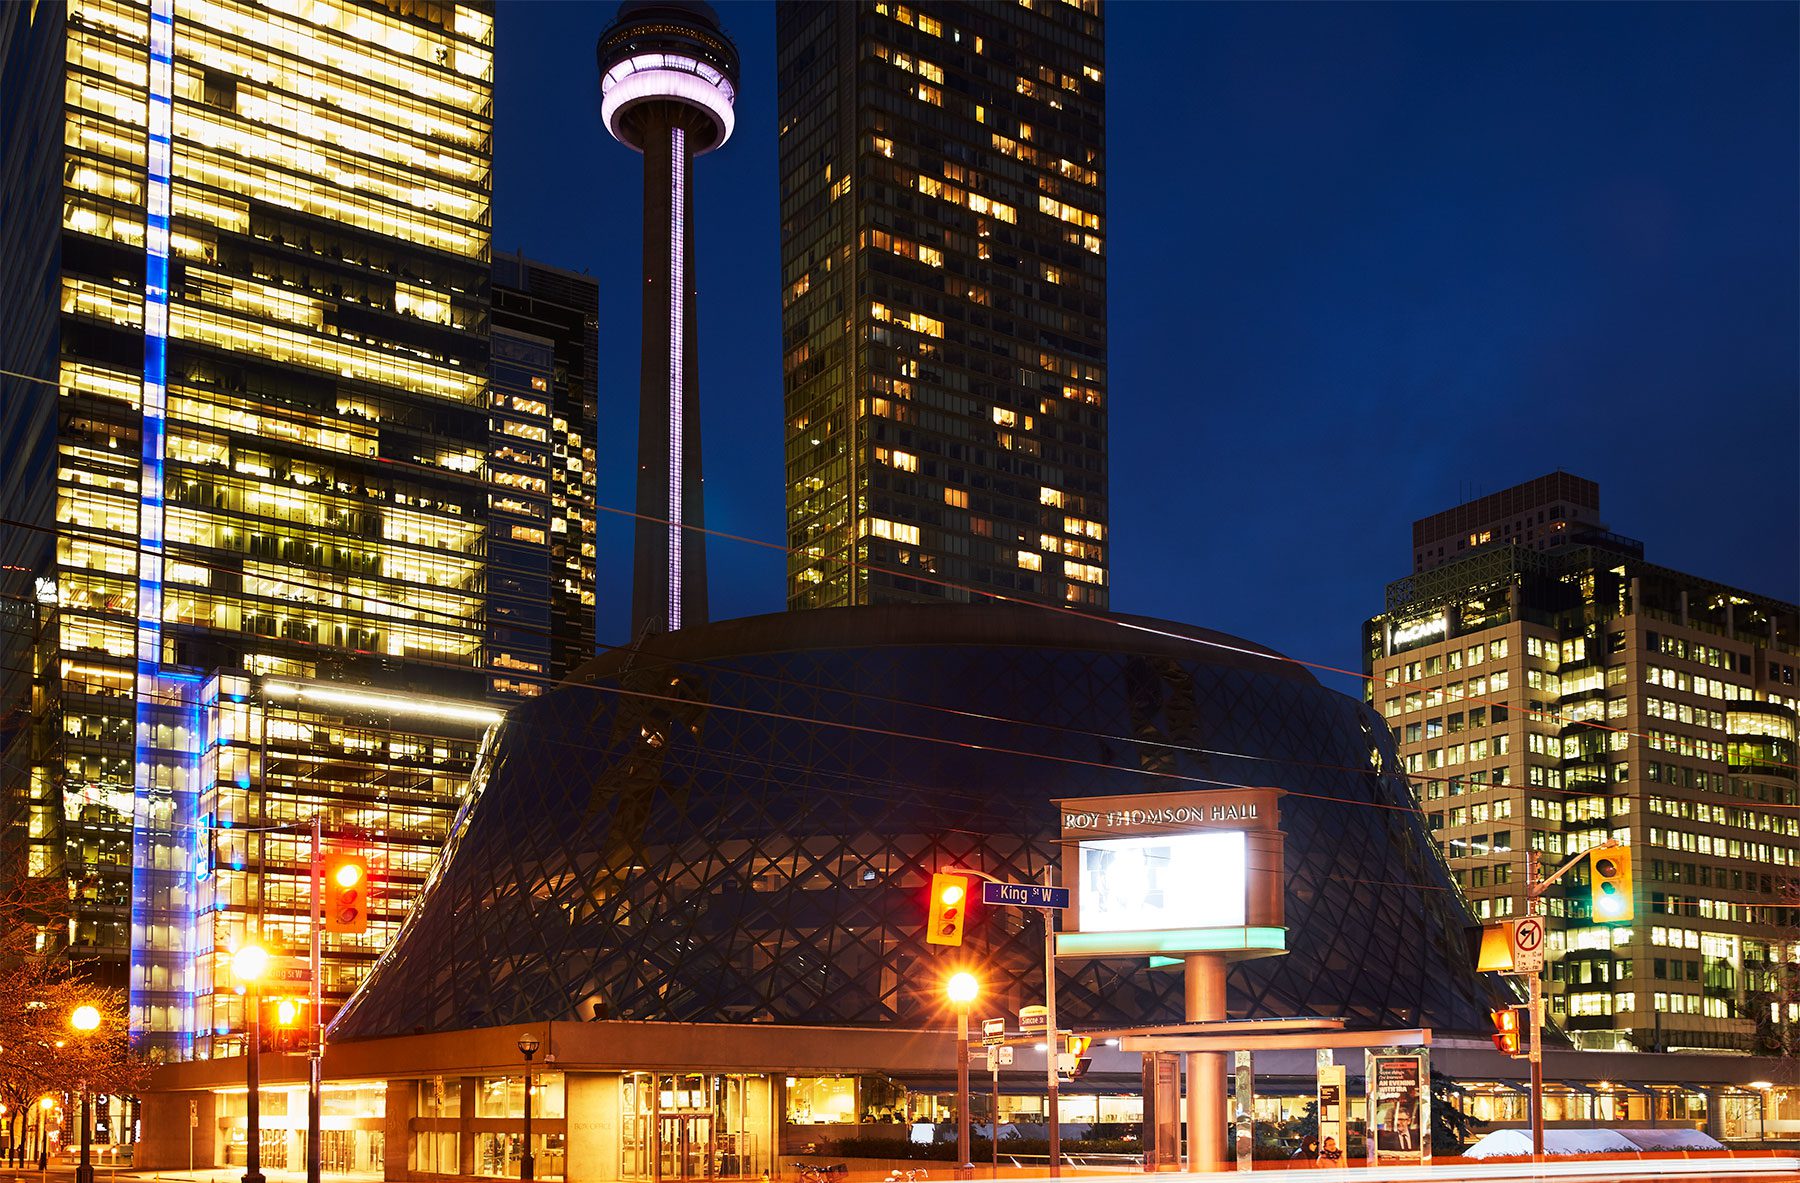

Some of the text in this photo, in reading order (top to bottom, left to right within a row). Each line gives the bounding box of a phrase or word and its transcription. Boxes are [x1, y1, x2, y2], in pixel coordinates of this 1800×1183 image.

[1064, 804, 1258, 829] ROY THOMSON HALL
[1001, 885, 1052, 904] King St W
